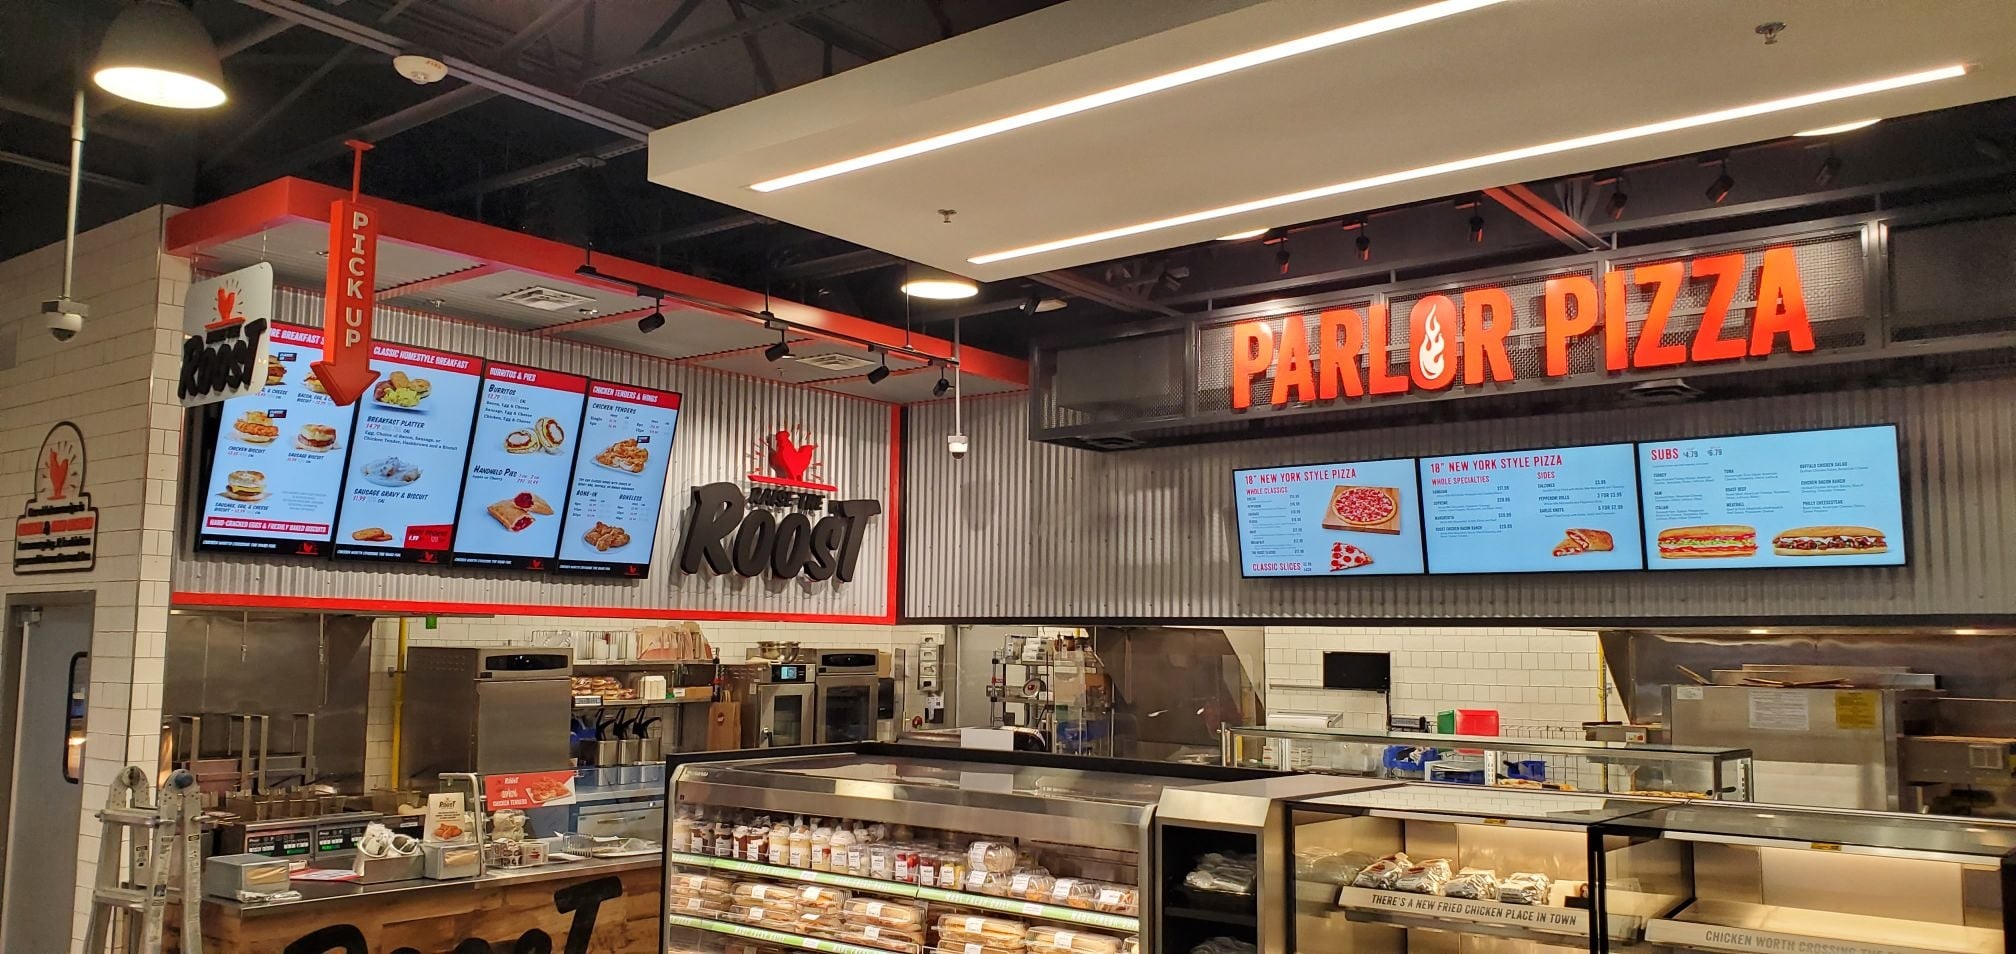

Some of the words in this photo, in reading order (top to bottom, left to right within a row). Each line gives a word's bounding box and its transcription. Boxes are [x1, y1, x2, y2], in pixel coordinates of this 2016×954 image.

[347, 211, 368, 299] PICK
[346, 307, 360, 348] UP
[1231, 289, 1514, 408] PARLOR
[1545, 247, 1815, 377] PIZZA
[282, 330, 320, 344] BREAKFAST
[374, 346, 400, 358] CLASSIC
[400, 350, 434, 364] HOMESTYLE
[435, 356, 469, 369] BREAKFAST
[592, 402, 614, 411] CHICKEN
[614, 406, 636, 414] TENDERS
[367, 416, 400, 426] BREAKFAST
[401, 420, 424, 428] PLATTER
[1652, 448, 1678, 460] SUBS
[1449, 461, 1469, 472] NEW
[1473, 459, 1497, 470] YORK
[1501, 458, 1530, 469] STYLE
[1534, 454, 1562, 466] PIZZA
[1260, 472, 1277, 484] NEW
[1280, 472, 1301, 482] YORK
[1304, 470, 1330, 482] STYLE
[1332, 468, 1356, 480] PIZZA
[1432, 478, 1452, 486] WHOLE
[1454, 476, 1490, 484] SPECIALTIES
[1537, 472, 1555, 480] SIDES
[354, 488, 380, 496] SAUSAGE
[1266, 486, 1288, 494] CLASSICS
[1372, 894, 1406, 908] THERE'S
[1408, 900, 1414, 908] A
[1416, 900, 1436, 912] NEW
[1438, 902, 1462, 914] FRIED
[1465, 904, 1502, 918] CHICKEN
[1506, 908, 1534, 920] PLACE
[1536, 912, 1546, 922] IN
[1550, 914, 1577, 926] TOWN
[1706, 930, 1752, 946] CHICKEN
[1756, 937, 1795, 951] WORTH
